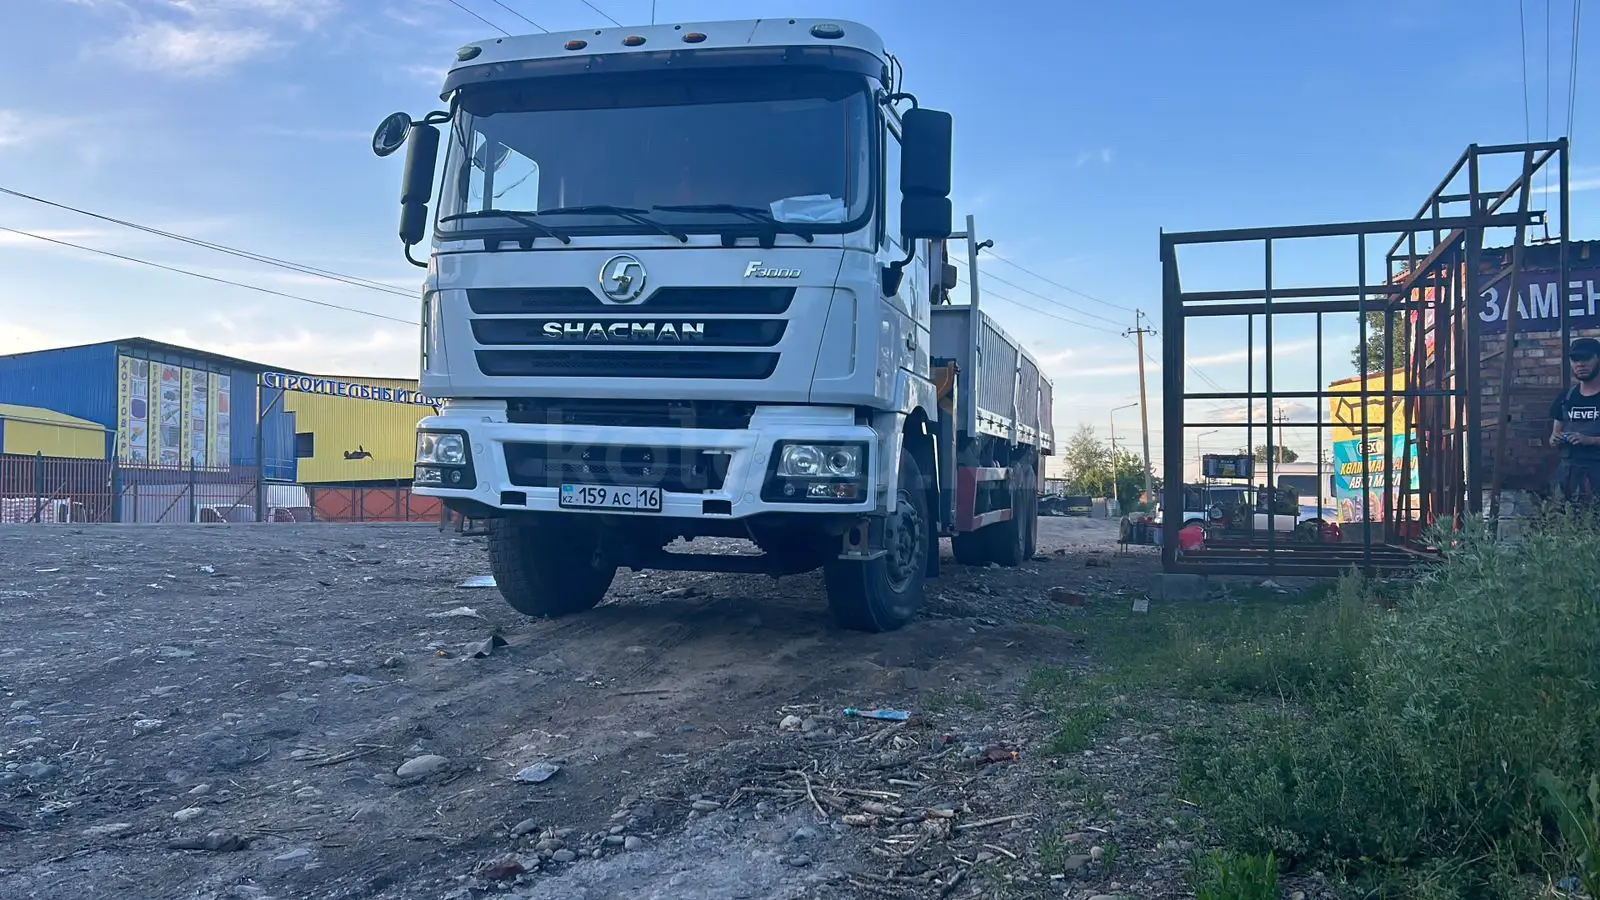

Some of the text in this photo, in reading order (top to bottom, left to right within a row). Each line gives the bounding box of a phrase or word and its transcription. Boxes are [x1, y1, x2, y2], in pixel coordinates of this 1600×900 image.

[744, 261, 802, 279] F3000
[542, 322, 705, 341] SHACMAN
[562, 487, 658, 507] KZ 159 AC 16
